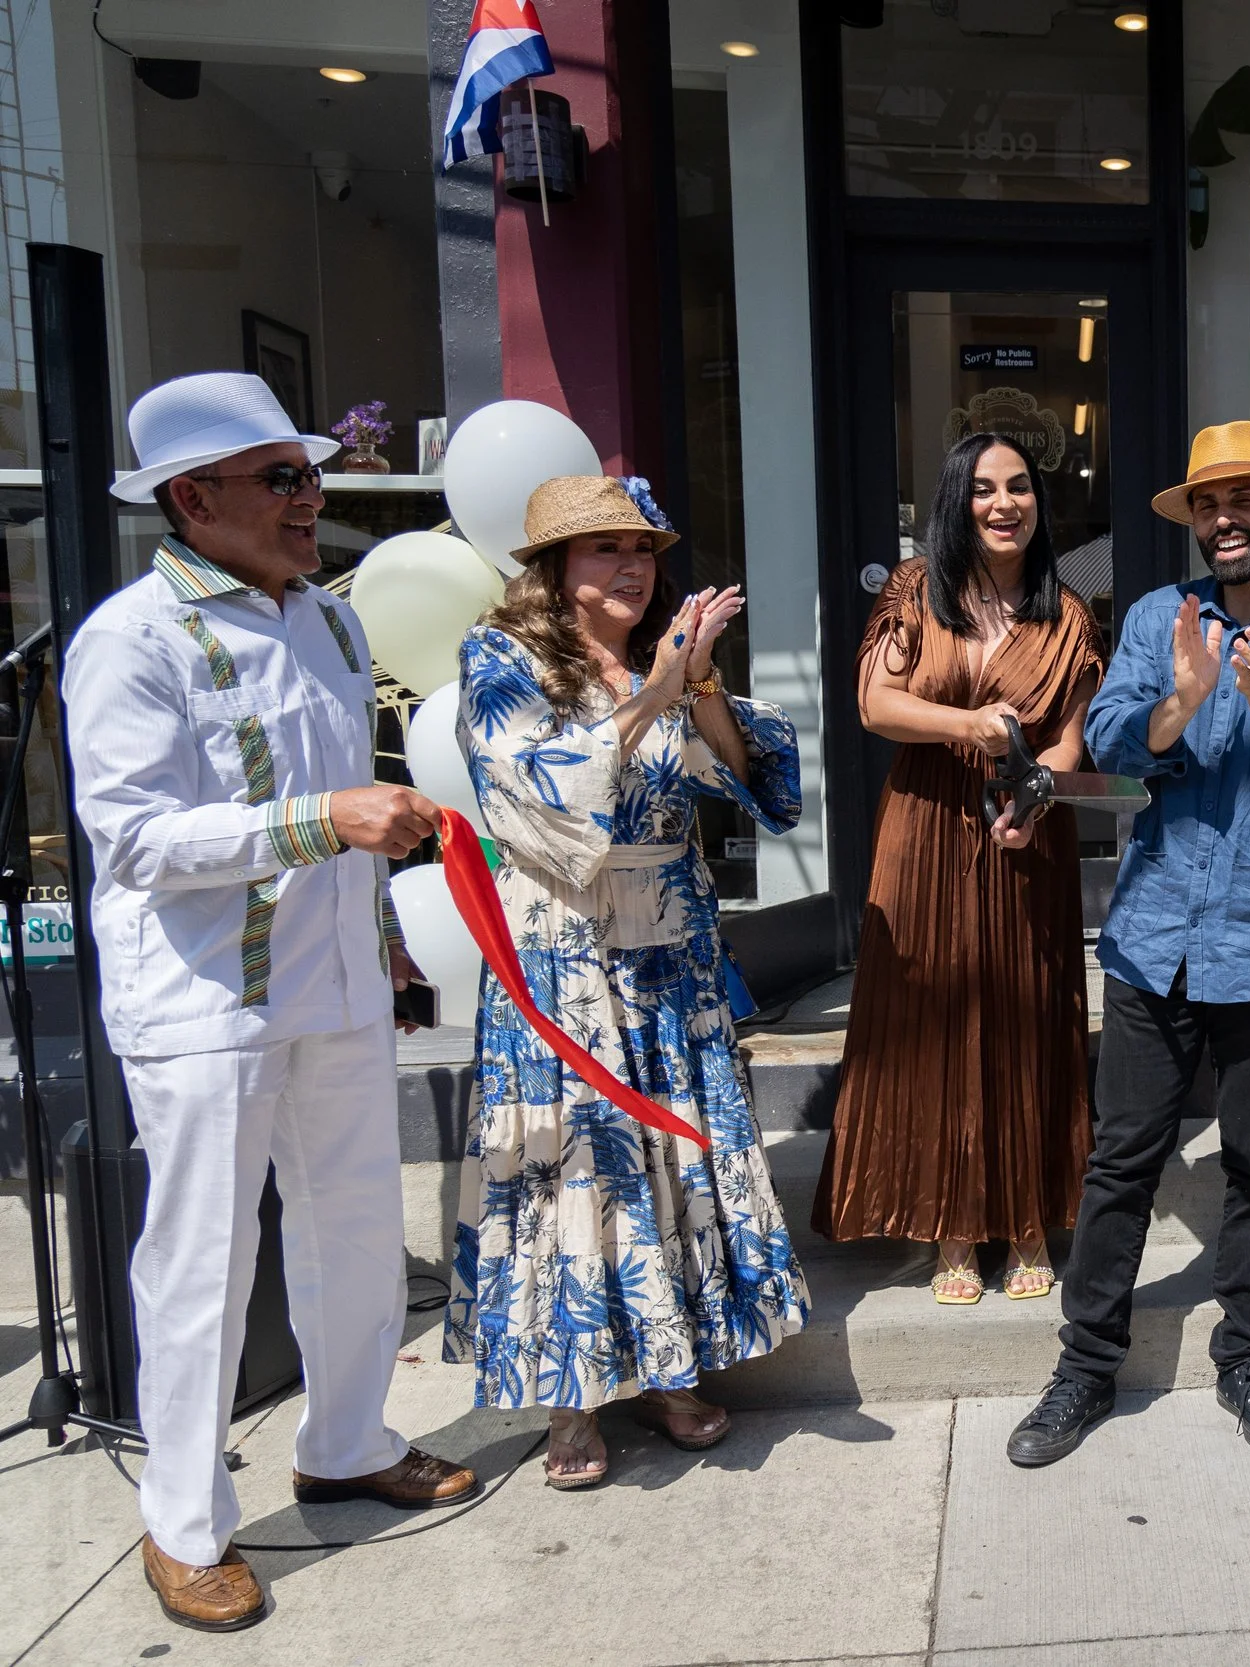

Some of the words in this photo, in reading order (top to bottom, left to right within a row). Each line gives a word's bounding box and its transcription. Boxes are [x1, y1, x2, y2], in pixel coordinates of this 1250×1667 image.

[958, 129, 1037, 160] 1809
[964, 351, 992, 365] Sorry
[996, 349, 1007, 357] No
[1008, 349, 1031, 358] Public
